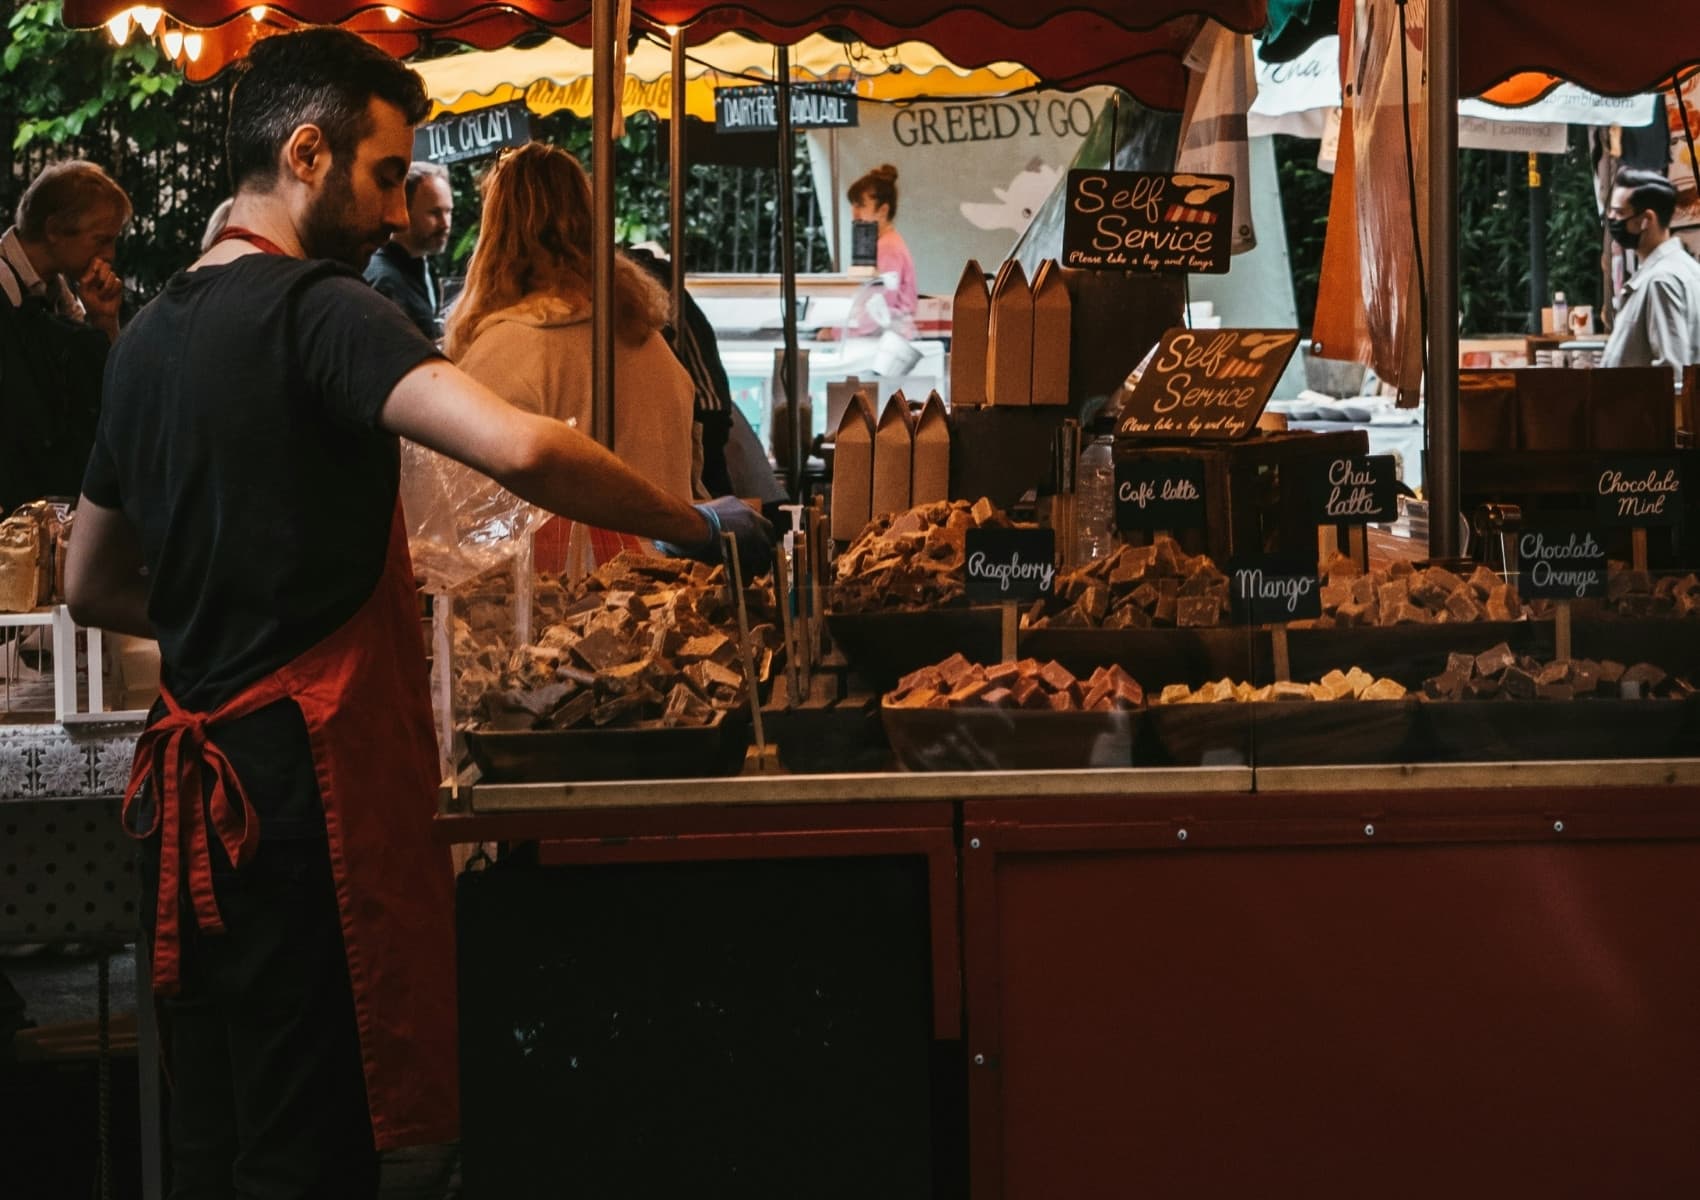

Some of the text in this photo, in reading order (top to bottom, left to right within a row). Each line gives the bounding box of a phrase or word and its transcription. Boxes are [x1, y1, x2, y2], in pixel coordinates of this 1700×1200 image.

[723, 95, 779, 128] DAIRY-FRE
[892, 97, 1095, 147] GREEDY GO
[426, 120, 457, 160] ICE
[459, 107, 512, 152] CREAM
[1074, 176, 1166, 224] Self
[1092, 214, 1214, 252] Service
[1069, 250, 1102, 264] Please
[1164, 254, 1186, 266] and
[1156, 332, 1240, 378] Self
[1153, 372, 1256, 413] Service
[1121, 416, 1151, 432] Please
[1176, 422, 1183, 430] a
[1203, 415, 1228, 430] and
[1328, 459, 1377, 486] Chai
[1598, 469, 1680, 495] Chocolate
[1119, 478, 1200, 509] Café latte
[1325, 486, 1383, 516] latte
[1617, 494, 1666, 517] Mint
[1520, 532, 1605, 559] Chocolate
[968, 551, 1055, 591] Raspberry
[1532, 560, 1599, 598] Orange
[1235, 568, 1315, 612] Mango
